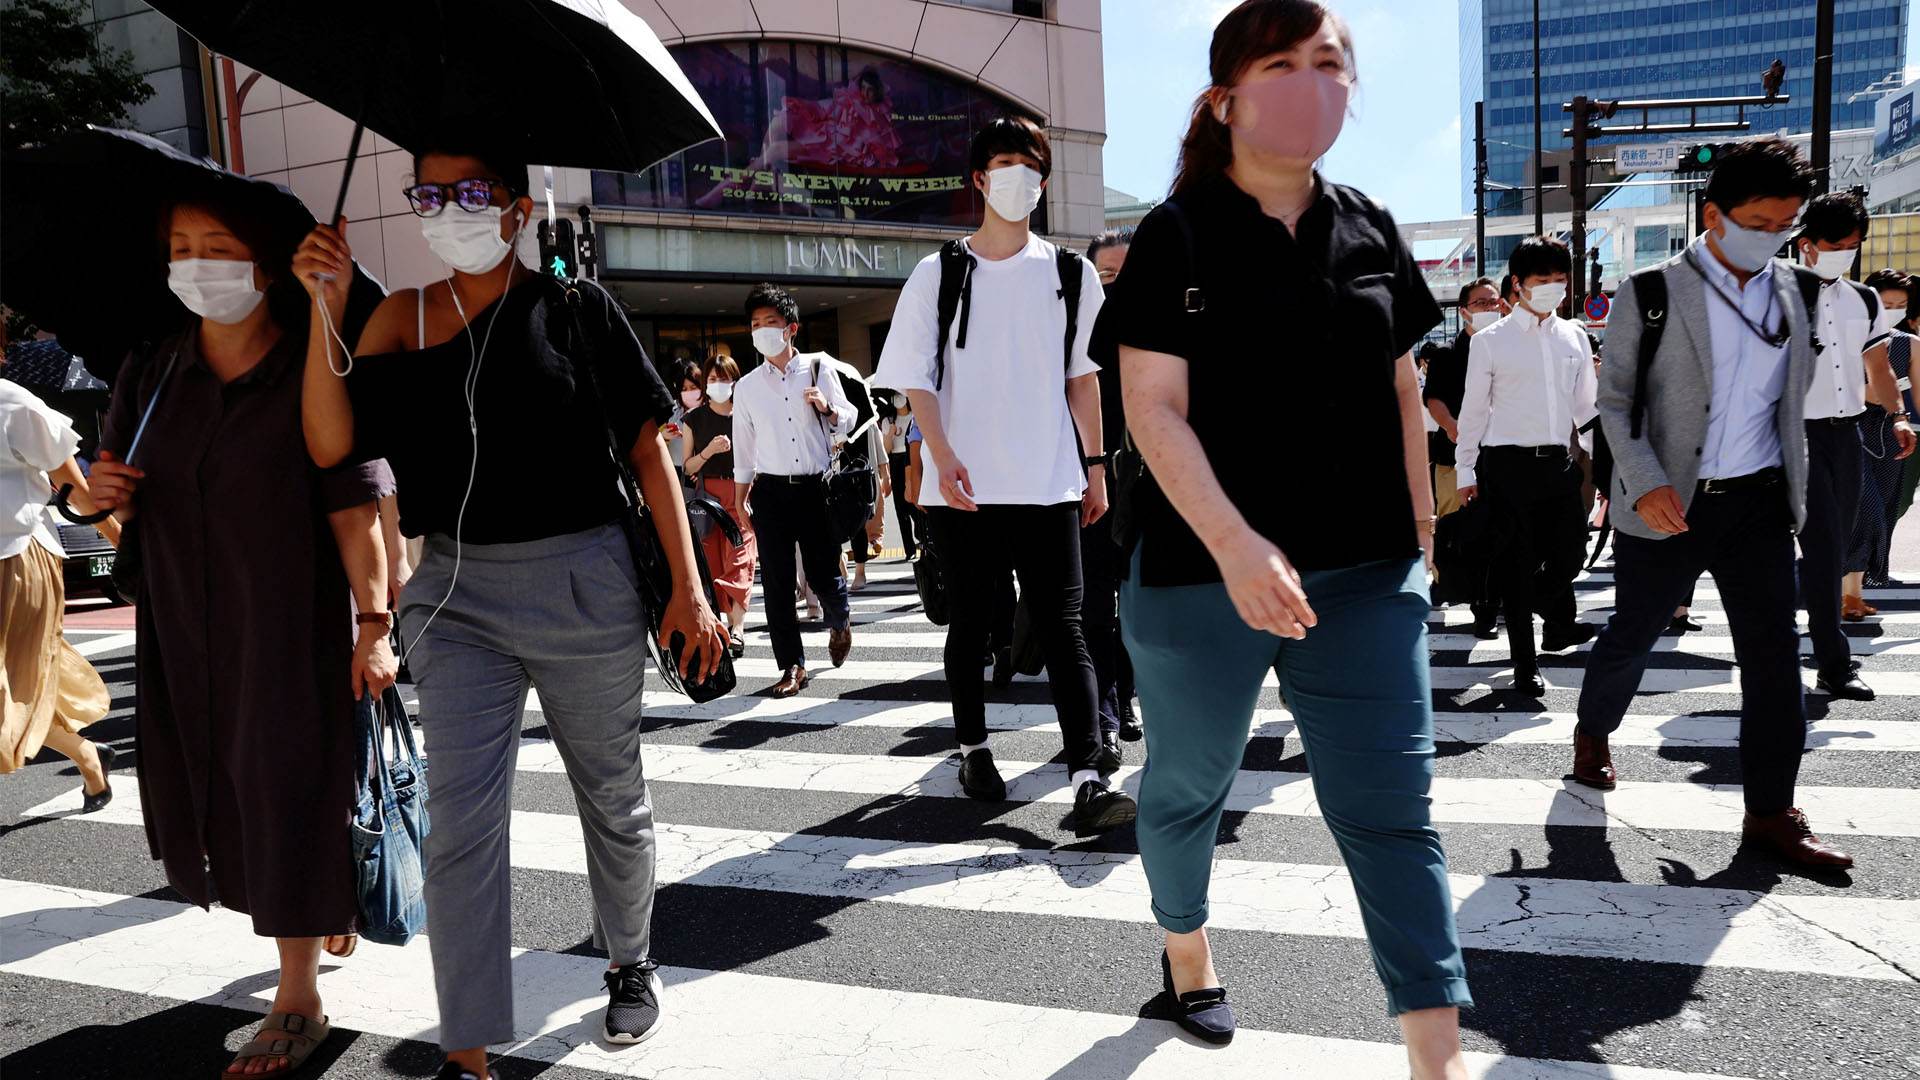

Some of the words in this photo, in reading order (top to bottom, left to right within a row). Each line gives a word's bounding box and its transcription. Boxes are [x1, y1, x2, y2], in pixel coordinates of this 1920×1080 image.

[1621, 147, 1674, 161] 西新宿一丁目
[878, 175, 965, 192] WEEK
[722, 187, 804, 204] 2021.7.26
[786, 240, 886, 271] LUMINE
[893, 245, 903, 270] 1
